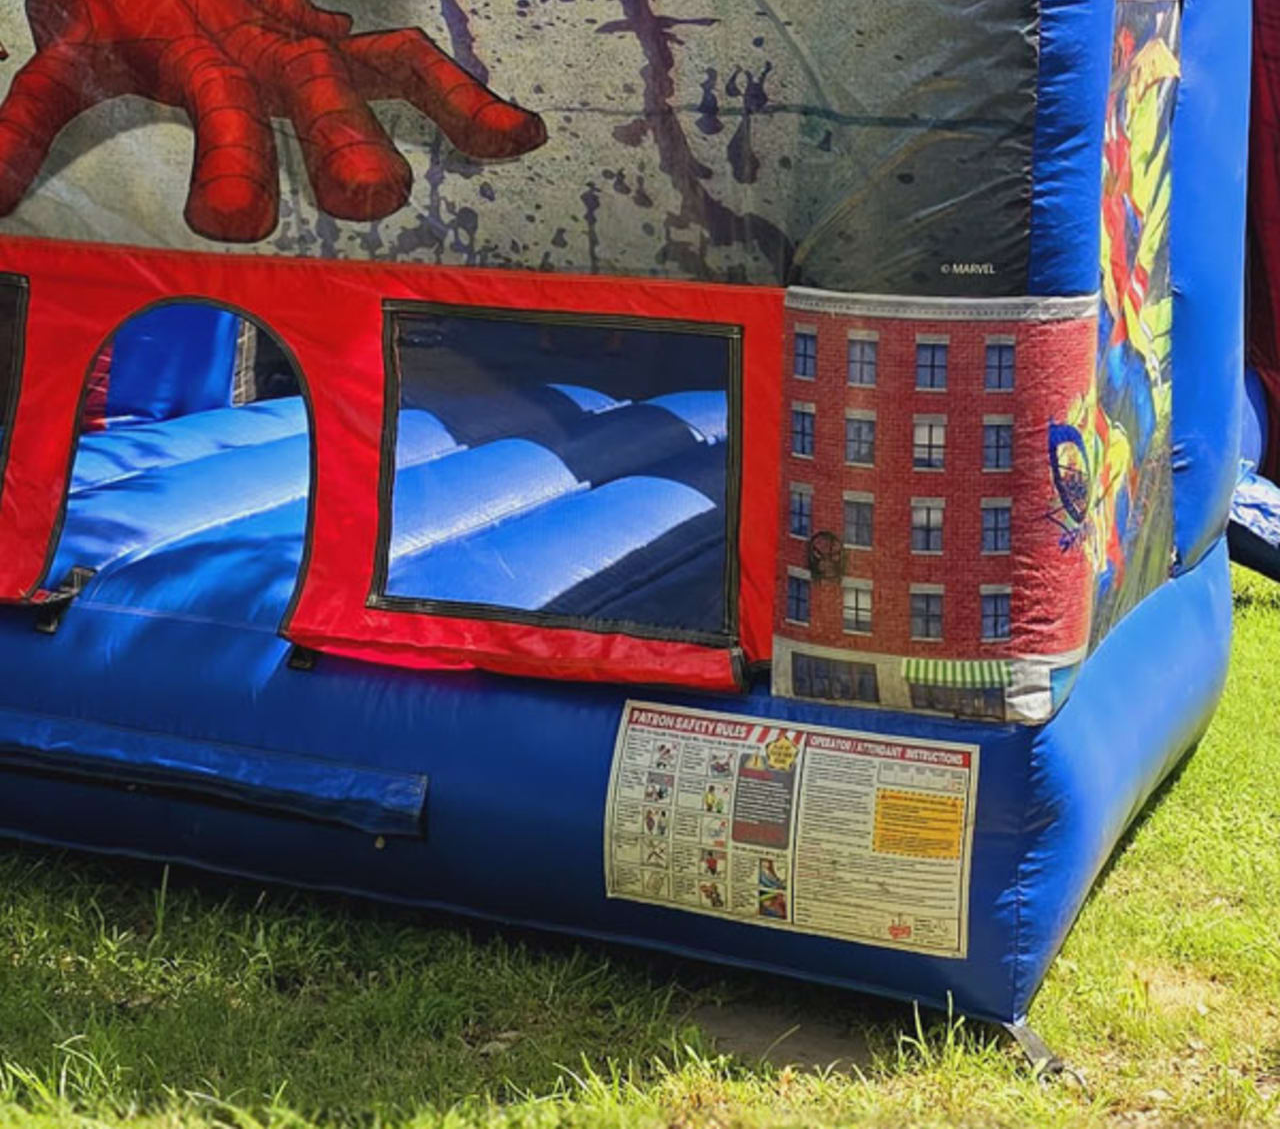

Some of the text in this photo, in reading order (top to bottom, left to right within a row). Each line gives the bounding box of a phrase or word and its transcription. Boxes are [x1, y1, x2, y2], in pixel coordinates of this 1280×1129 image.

[952, 263, 996, 274] MARVEL
[631, 709, 747, 738] PATRON SAFETY RULES
[904, 748, 964, 766] INSTRUCTIONS
